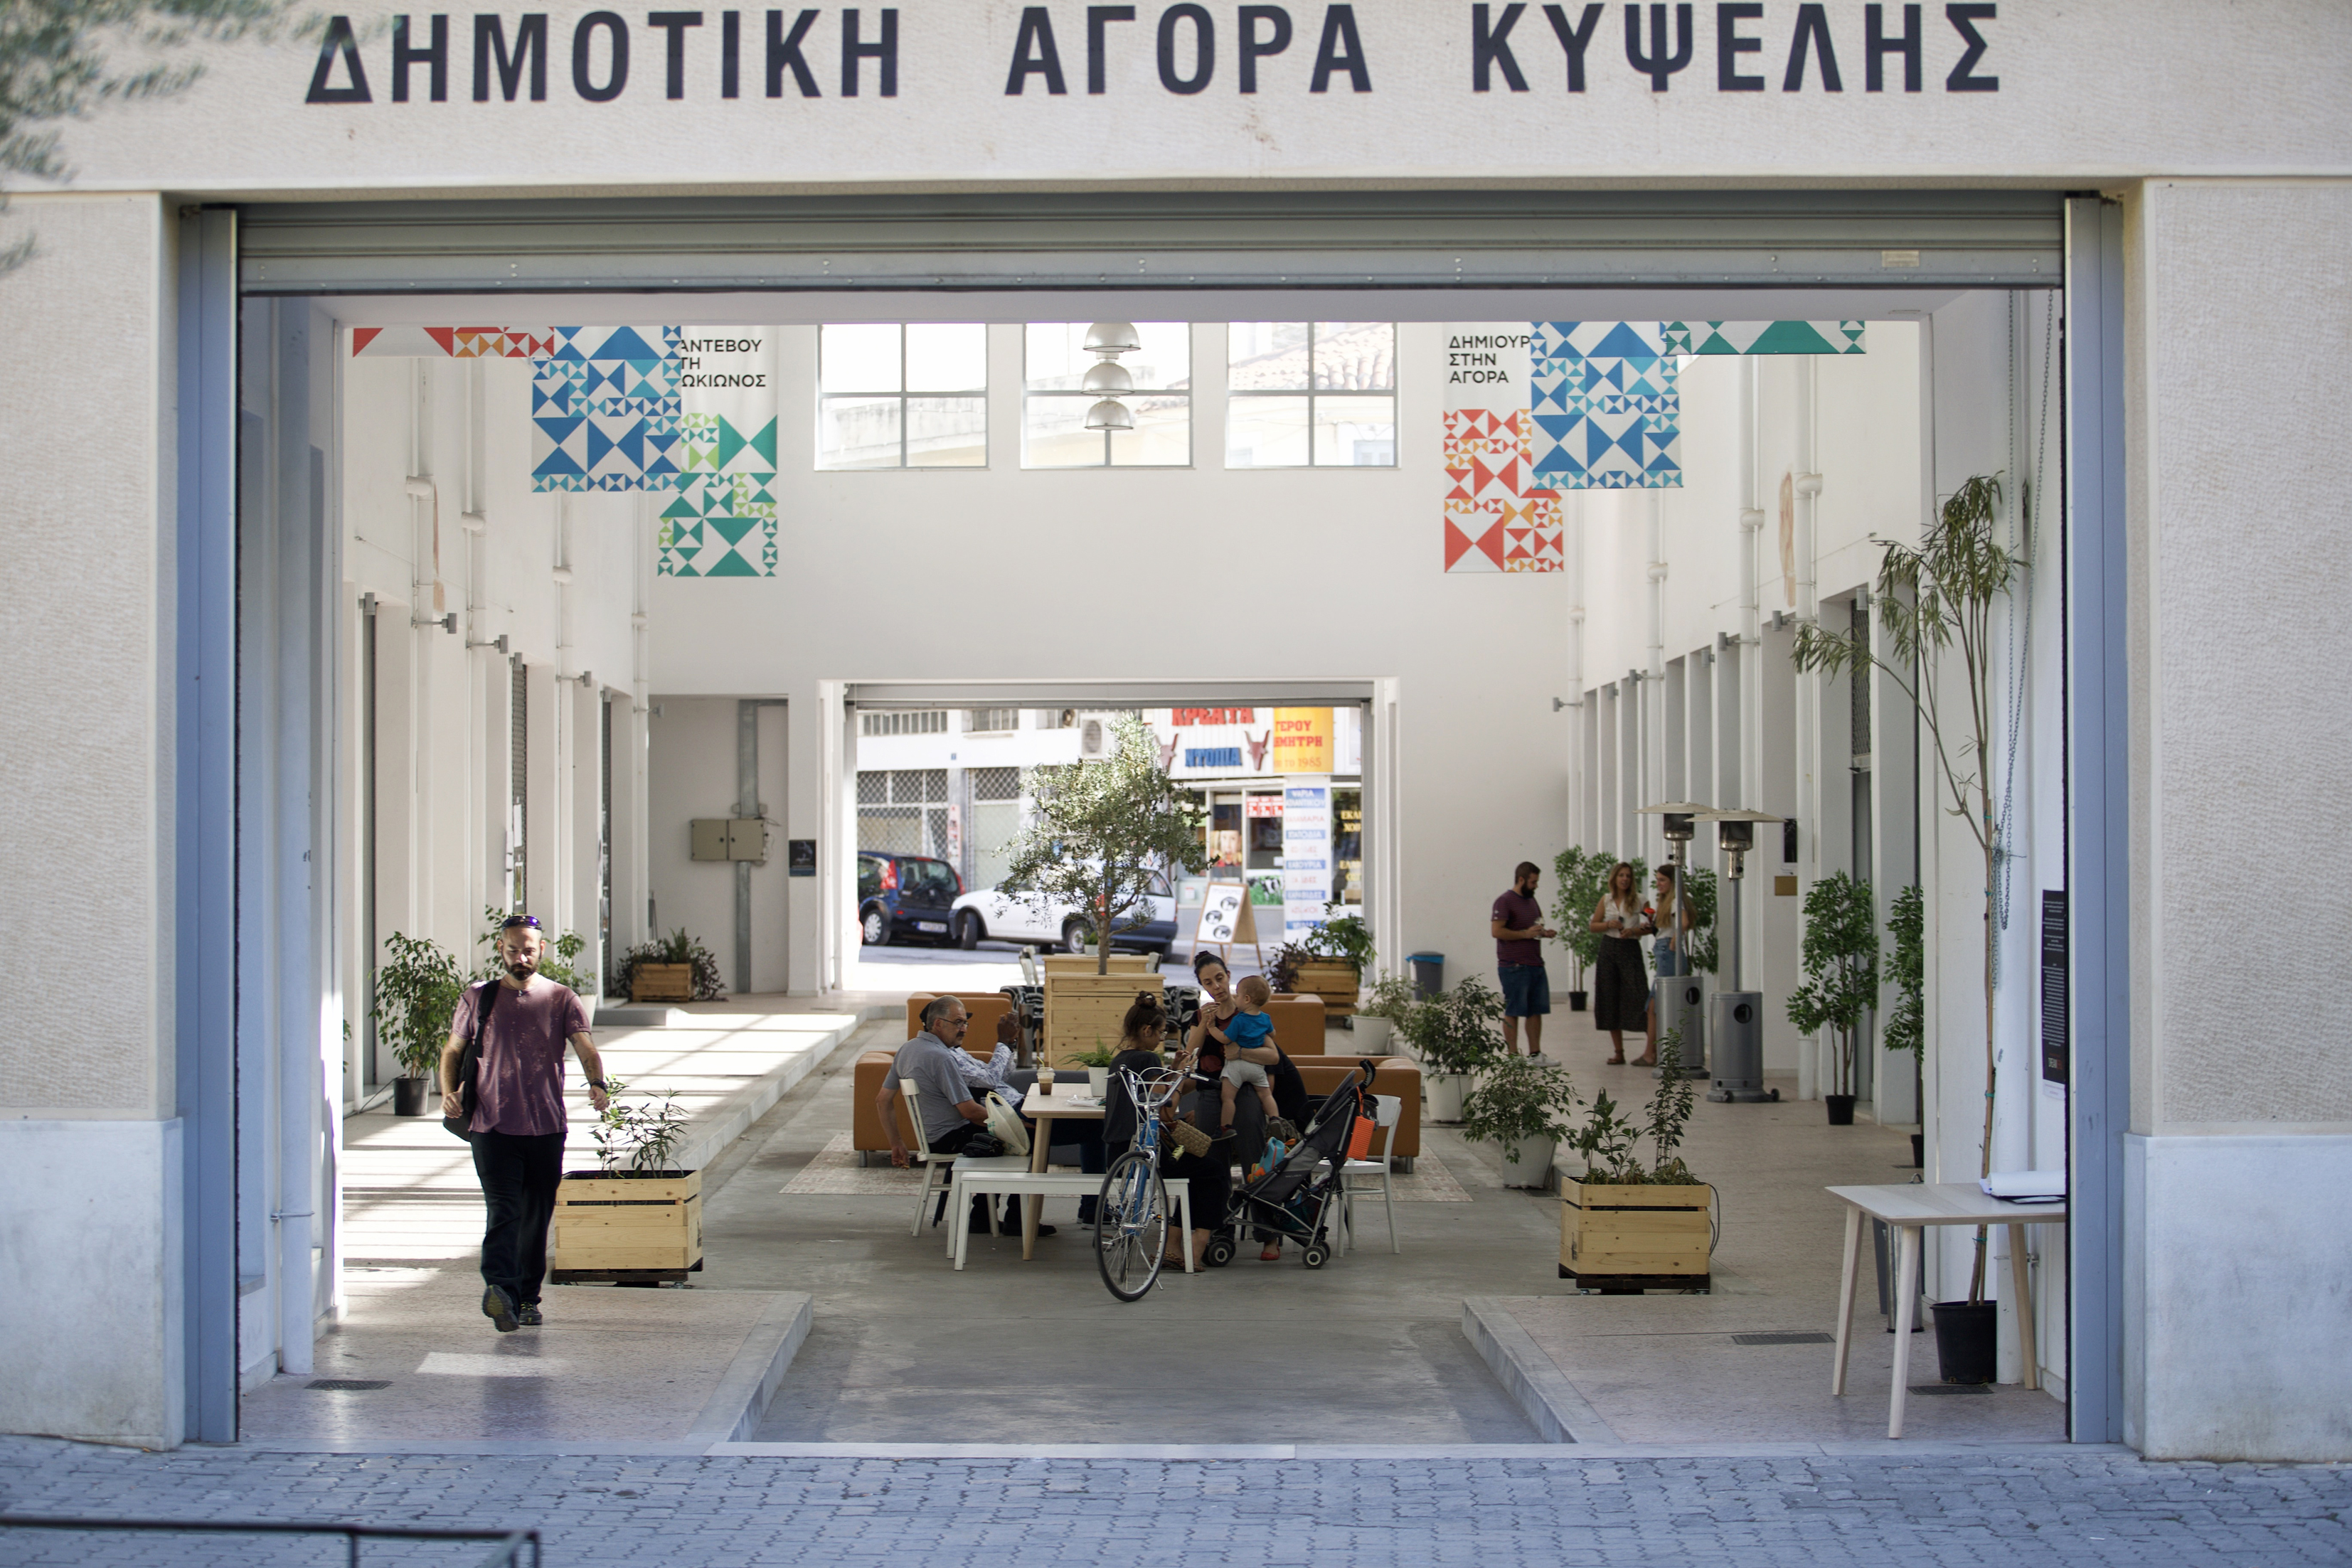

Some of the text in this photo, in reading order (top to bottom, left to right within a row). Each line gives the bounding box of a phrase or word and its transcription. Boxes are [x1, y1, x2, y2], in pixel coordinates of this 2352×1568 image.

[304, 3, 2000, 103] ΔΗΜΟΤΙΚΗ ΑΓΟΡΑ ΚΥΨΕΛΗΣ
[1449, 353, 1496, 366] ΣΤΗΝ
[1449, 370, 1509, 383] ΑΓΟΡΑ
